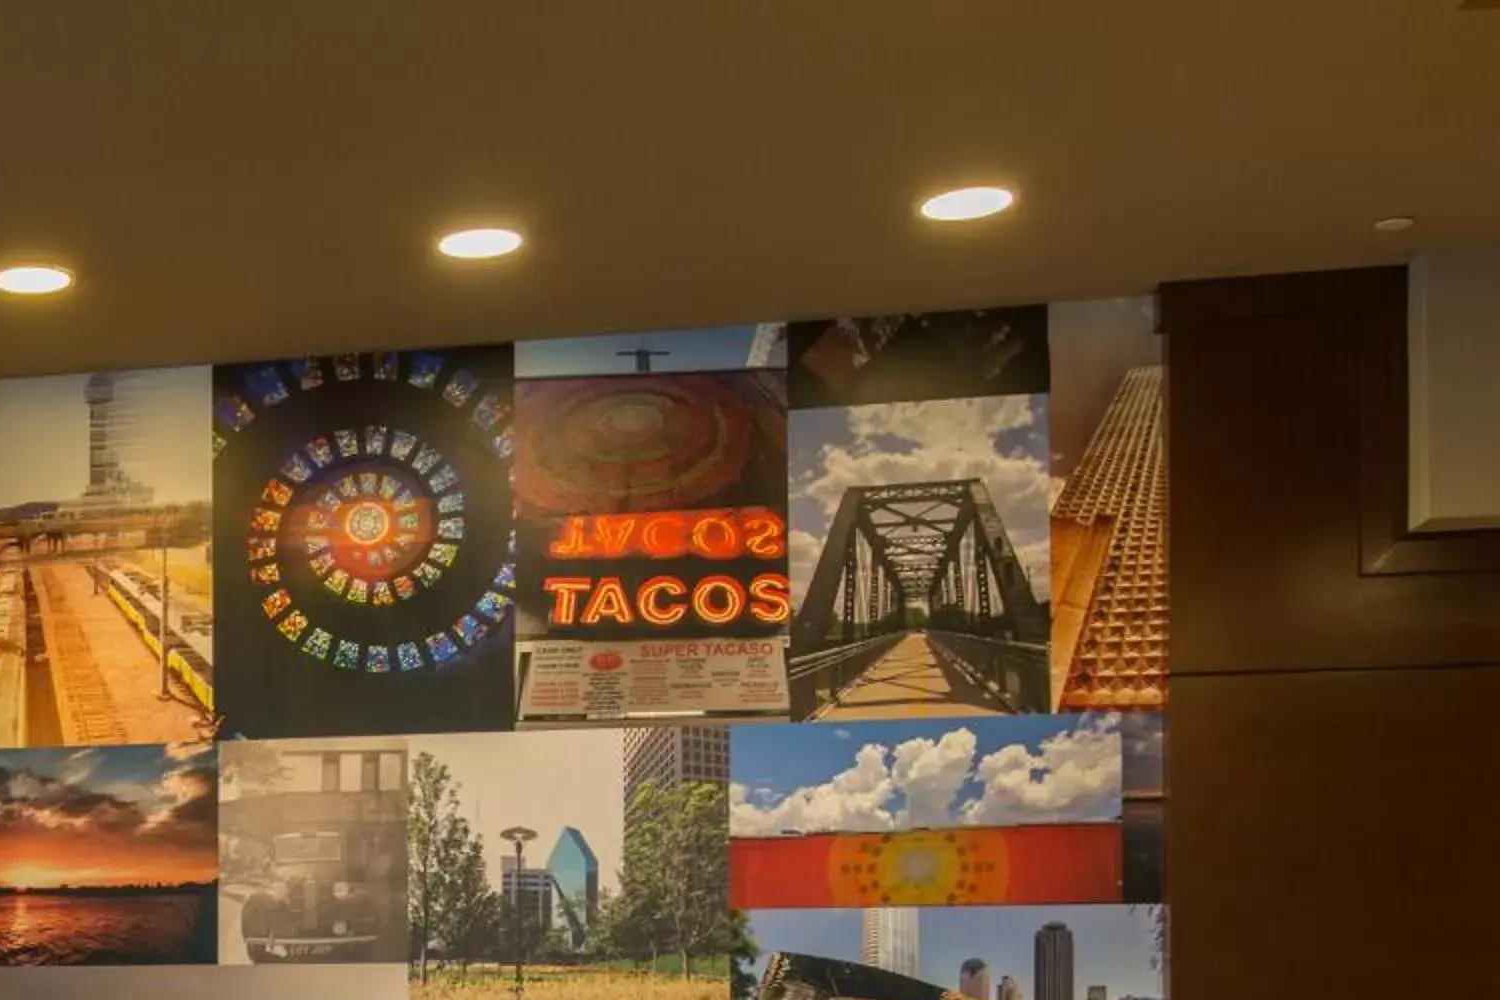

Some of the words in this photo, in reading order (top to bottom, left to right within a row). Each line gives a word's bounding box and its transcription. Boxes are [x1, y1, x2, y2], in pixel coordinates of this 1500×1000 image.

[544, 573, 790, 625] TACOS
[639, 644, 698, 658] SUPER
[705, 642, 773, 657] TACASO
